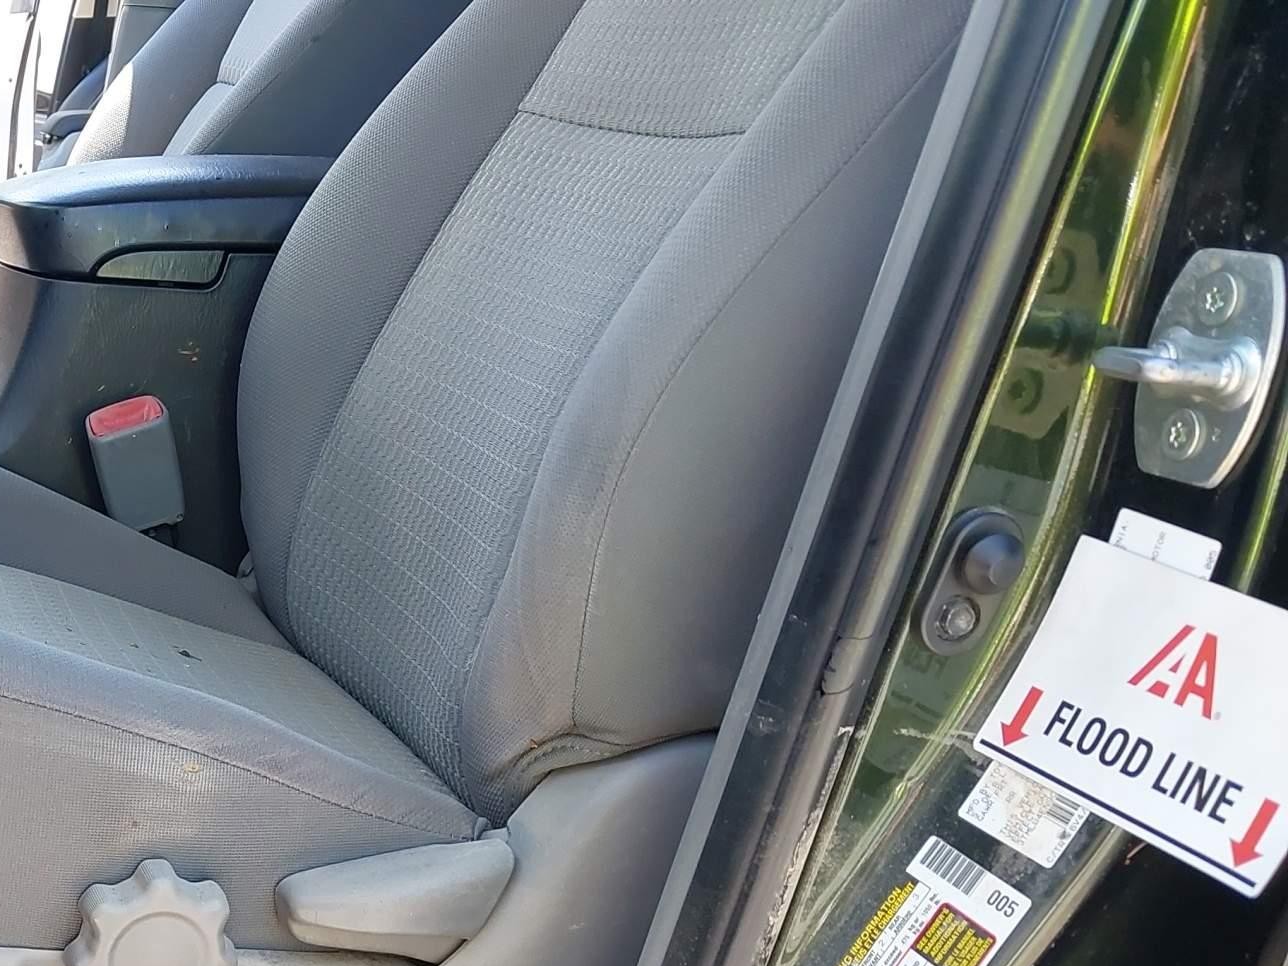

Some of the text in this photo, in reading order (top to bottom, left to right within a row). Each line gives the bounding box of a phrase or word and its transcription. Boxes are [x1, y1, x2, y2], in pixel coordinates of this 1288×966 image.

[1044, 700, 1243, 824] FLOOD LINE
[850, 887, 901, 955] INFORMATION
[864, 938, 873, 949] ET
[871, 928, 880, 939] LE
[878, 882, 914, 929] CHARGEMENT
[986, 890, 1020, 918] 005
